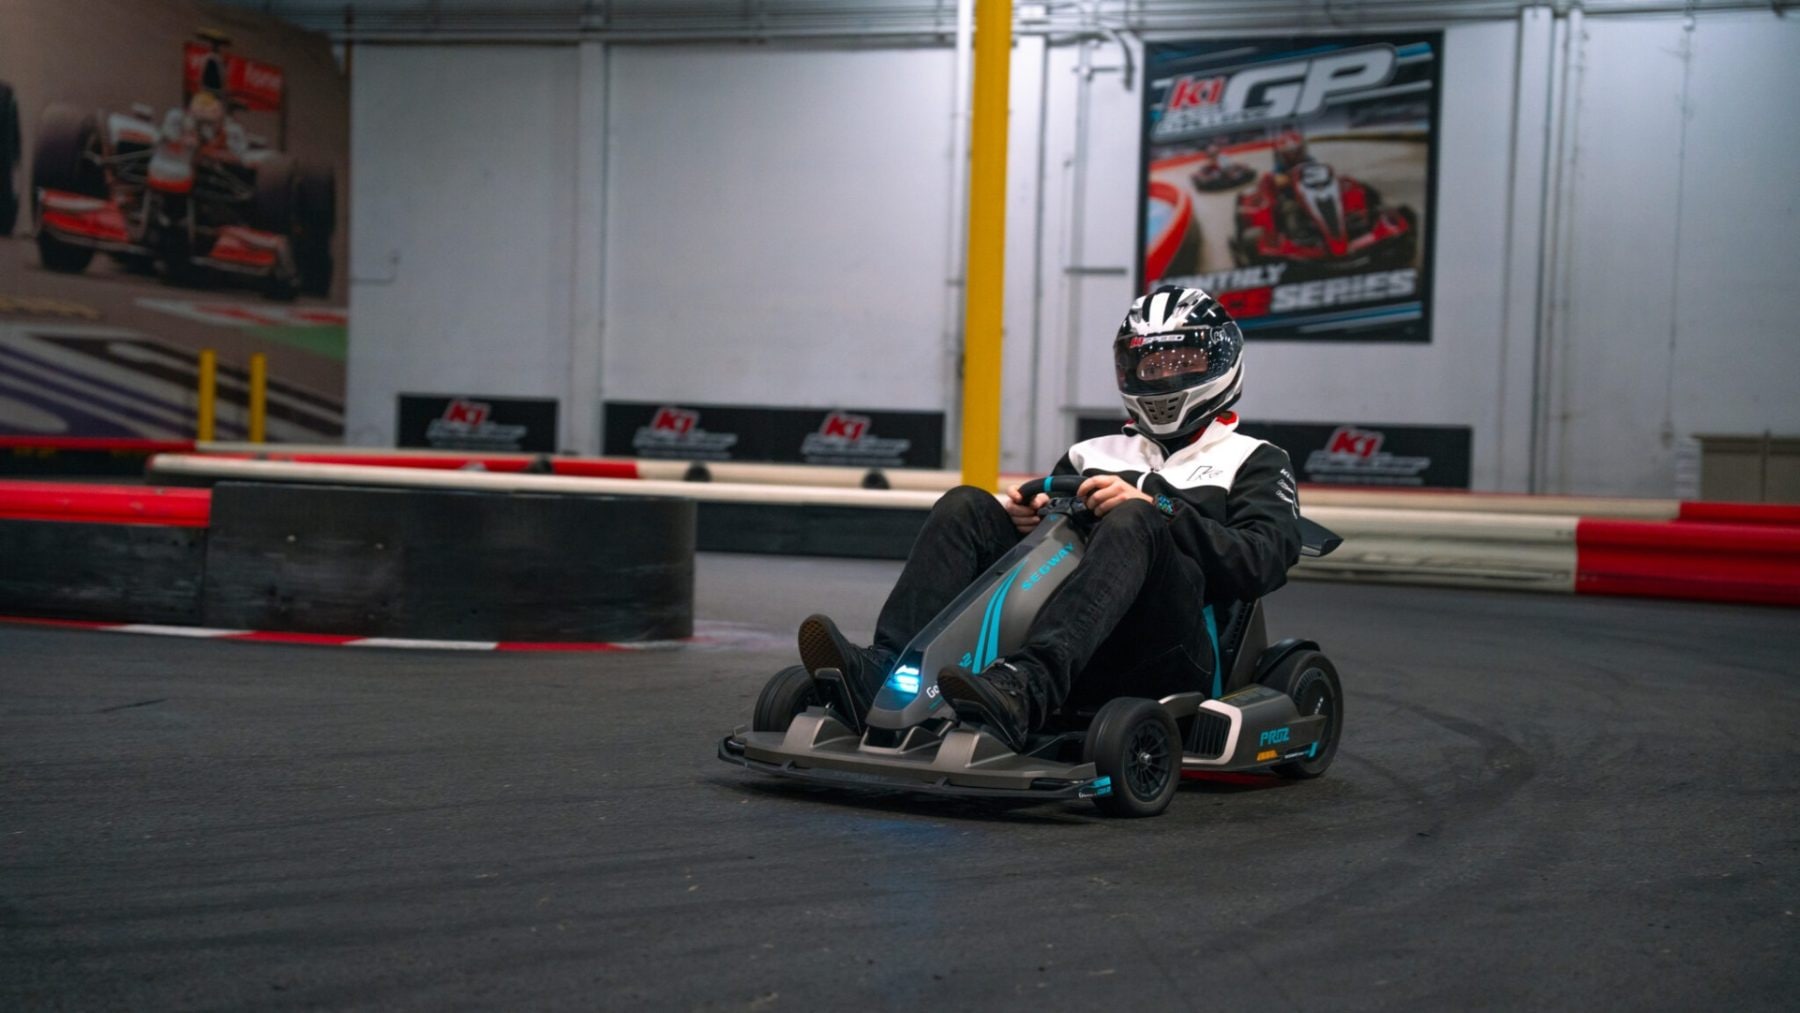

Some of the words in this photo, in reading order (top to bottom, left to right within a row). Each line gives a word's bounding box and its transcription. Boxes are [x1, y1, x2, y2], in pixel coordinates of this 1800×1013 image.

[1168, 76, 1225, 111] K1
[1222, 47, 1397, 120] GP
[1271, 268, 1418, 313] SERIES
[445, 400, 487, 428] K1
[653, 406, 696, 434] K1
[823, 412, 867, 442] K1
[1329, 429, 1380, 458] K1
[1021, 541, 1074, 591] SEGWAY
